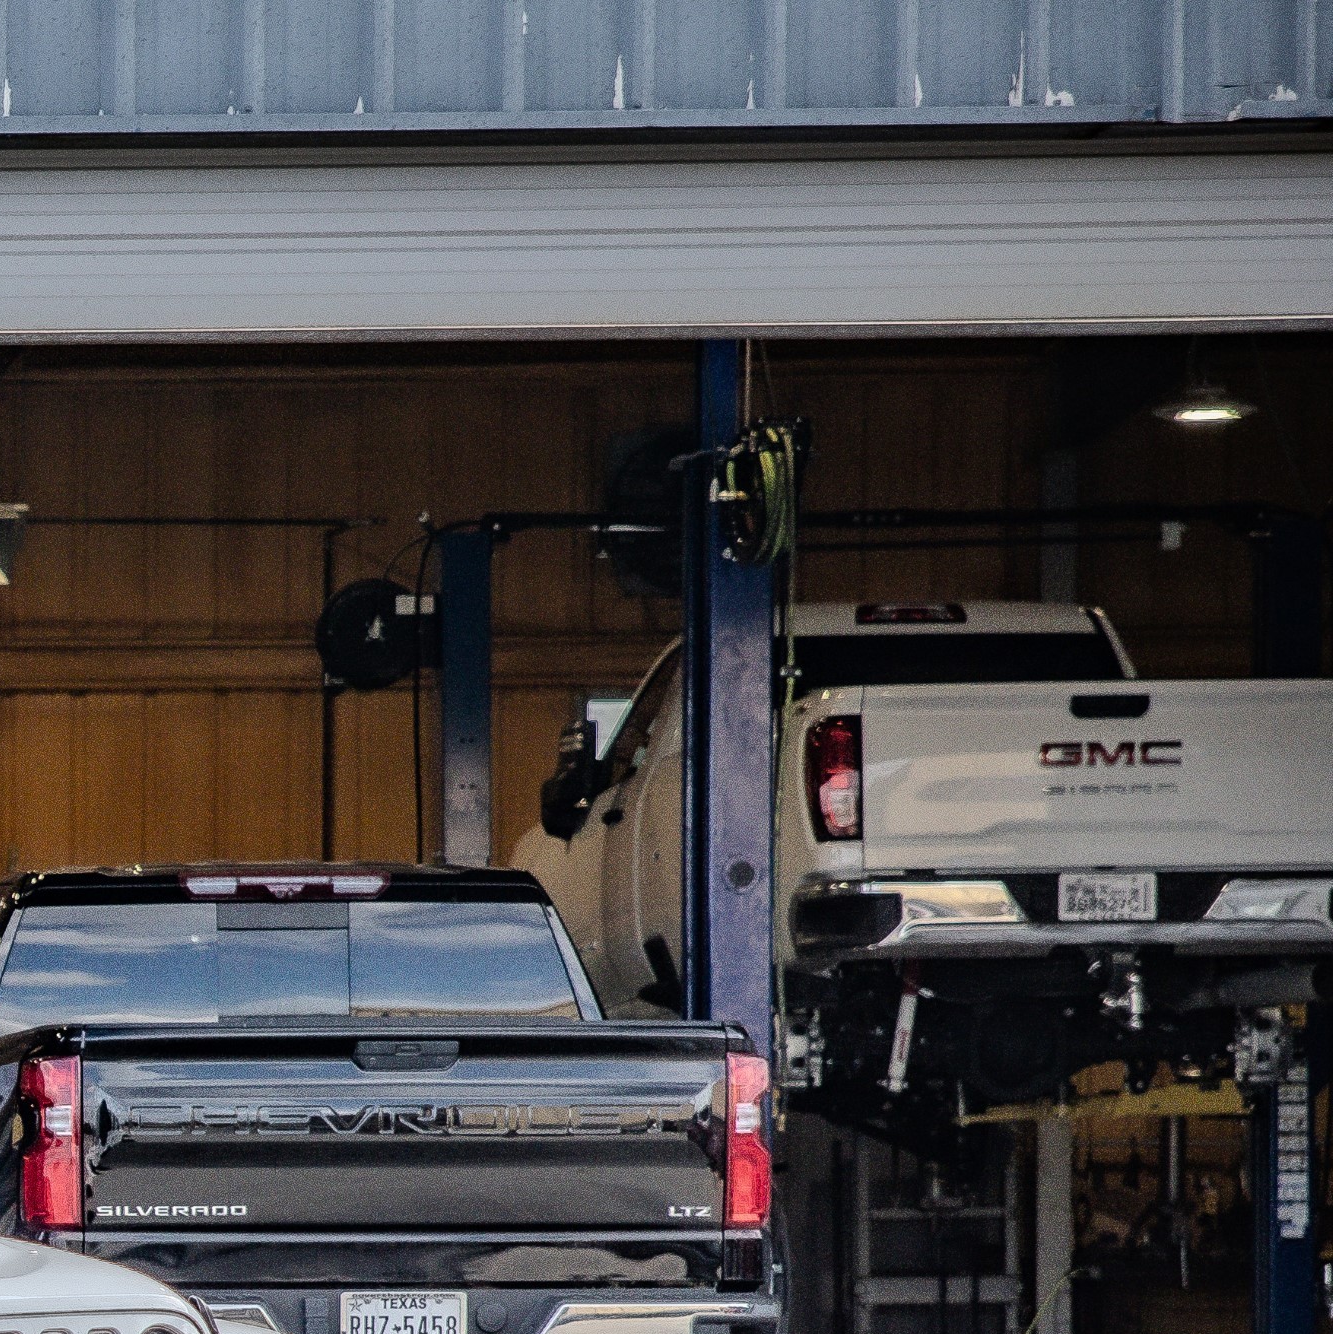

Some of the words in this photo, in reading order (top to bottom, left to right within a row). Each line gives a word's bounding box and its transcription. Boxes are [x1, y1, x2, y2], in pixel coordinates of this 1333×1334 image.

[1040, 740, 1182, 767] GMC
[129, 1104, 683, 1135] CHEVROLET
[95, 1205, 247, 1217] SILVERADO
[667, 1205, 711, 1218] LTZ
[381, 1298, 427, 1310] TEXAS
